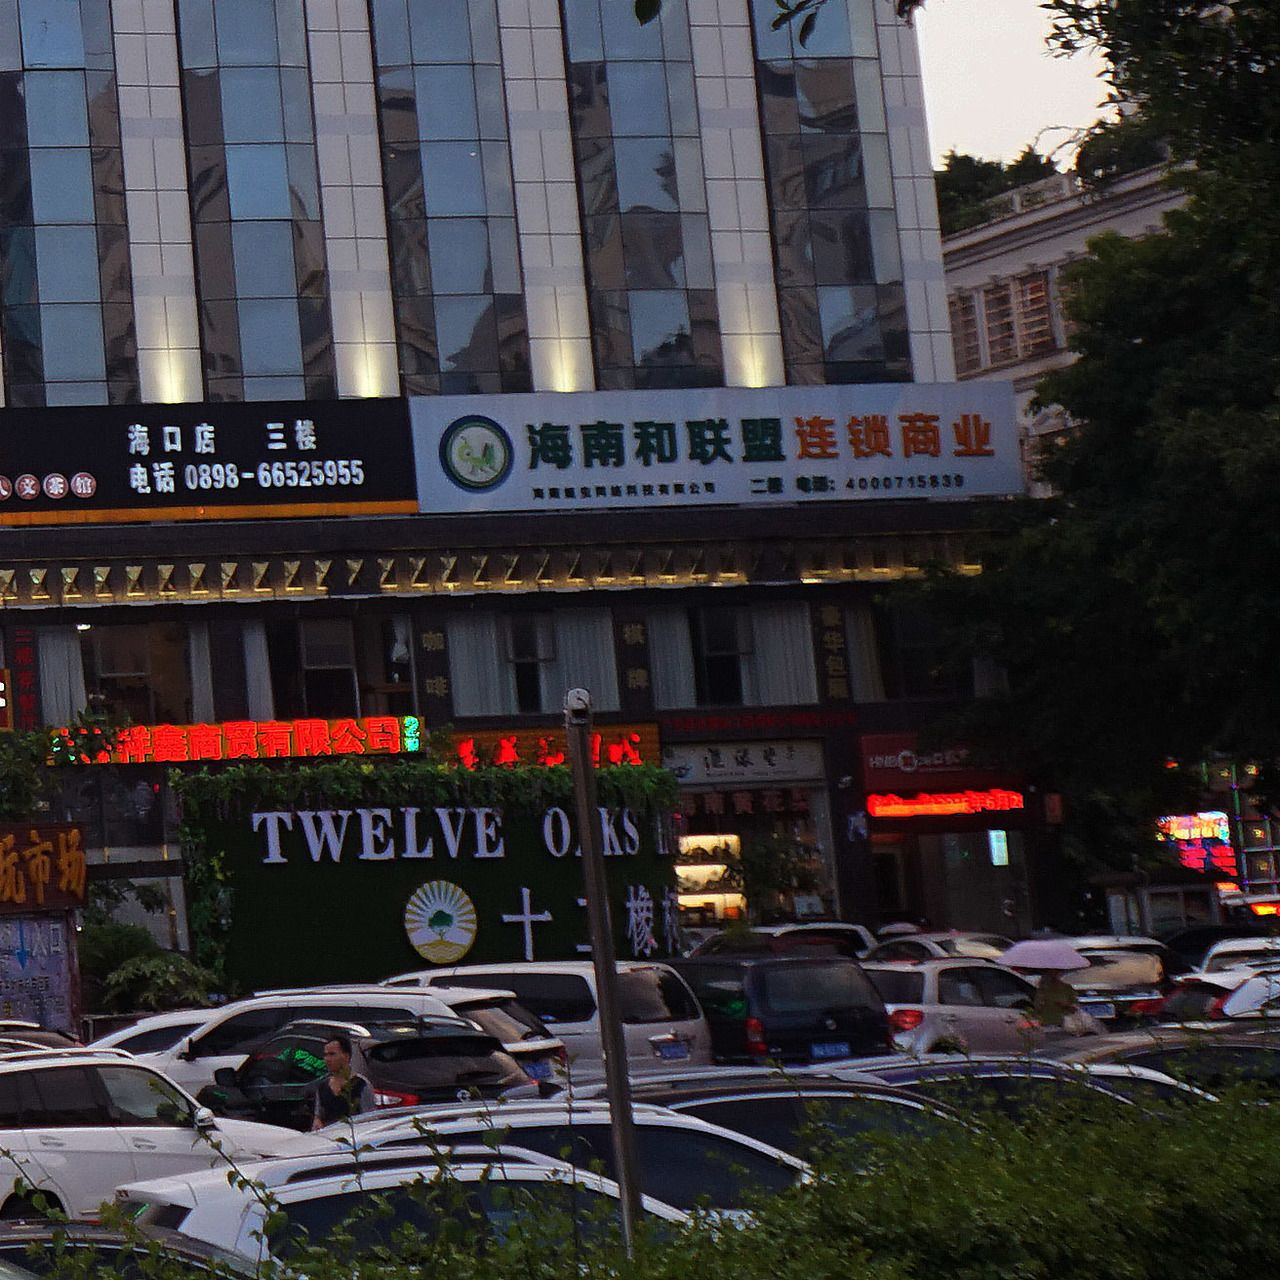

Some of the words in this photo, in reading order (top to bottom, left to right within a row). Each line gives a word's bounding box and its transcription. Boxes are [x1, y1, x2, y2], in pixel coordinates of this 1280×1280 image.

[127, 422, 216, 456] 海口店
[266, 419, 316, 451] 三楼
[184, 460, 365, 490] 0898-66525955
[60, 717, 402, 764] 祥鑫商贸有限公司
[252, 805, 505, 864] TWELVE
[543, 806, 640, 858] OKS
